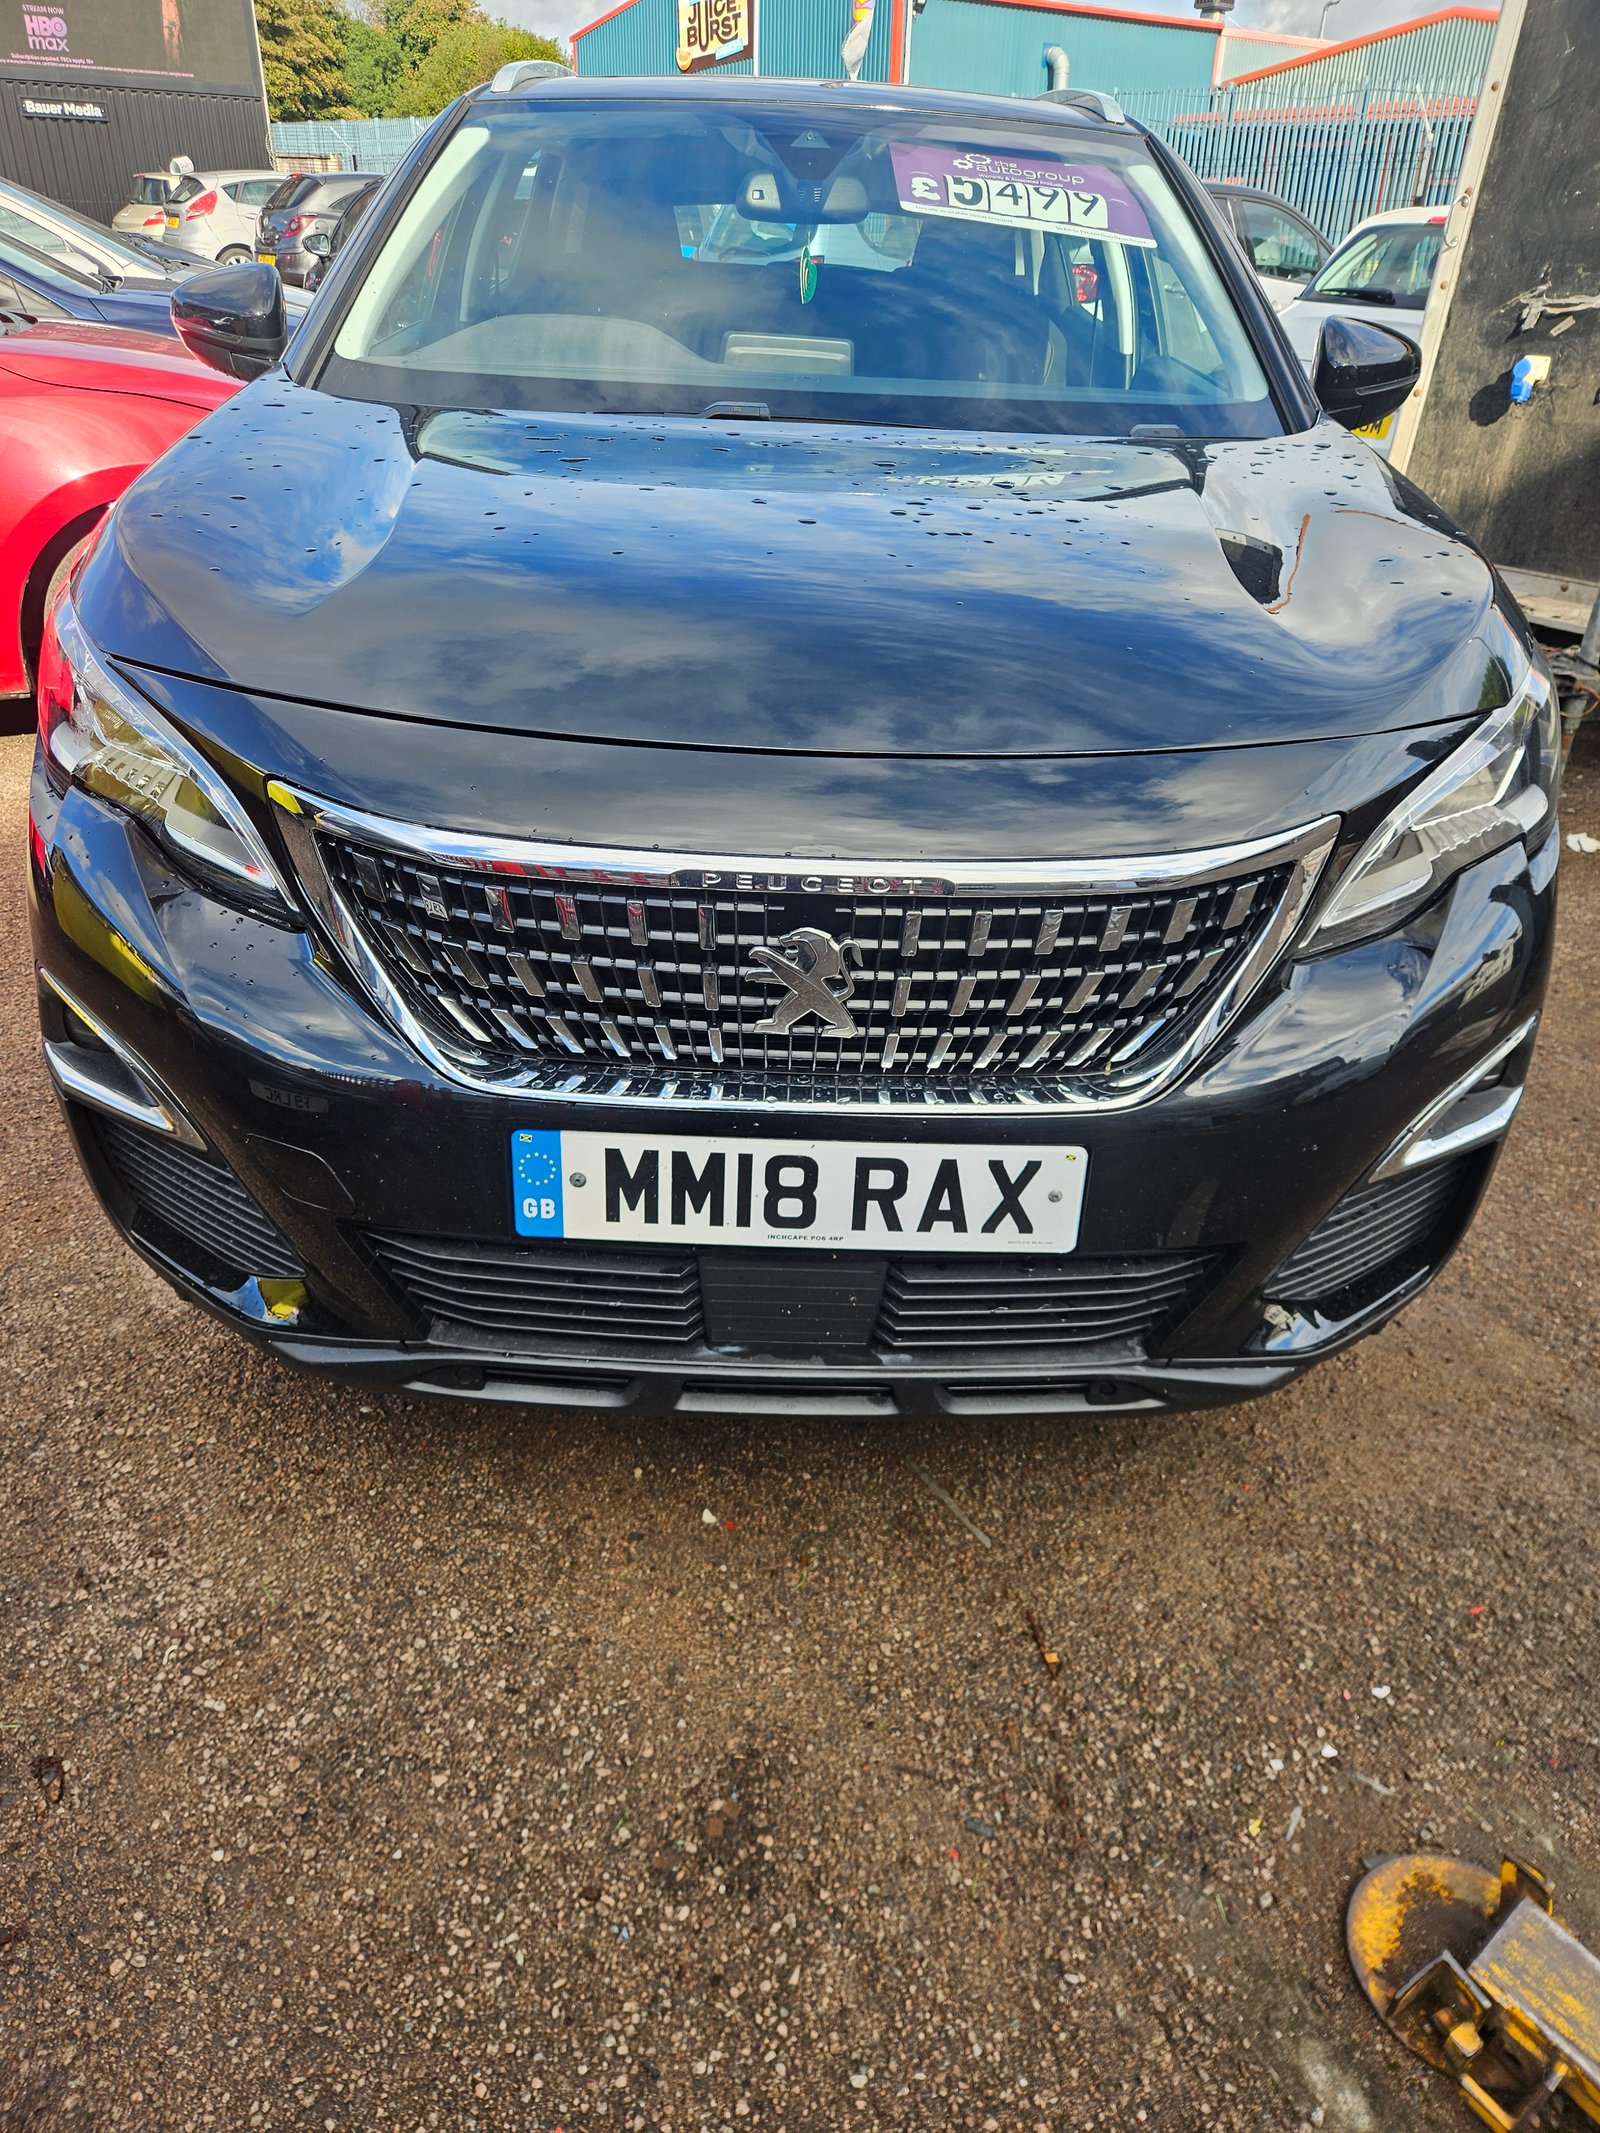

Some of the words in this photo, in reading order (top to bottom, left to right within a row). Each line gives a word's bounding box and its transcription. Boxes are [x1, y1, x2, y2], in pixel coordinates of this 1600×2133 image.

[22, 4, 48, 13] STREAM
[47, 6, 64, 15] NOW
[23, 14, 68, 38] HBO
[687, 12, 741, 52] BURST
[27, 35, 70, 52] max
[24, 100, 63, 115] Bauer
[63, 102, 103, 118] Media
[976, 164, 1085, 186] autogroup
[994, 160, 1017, 169] the
[702, 872, 922, 895] PEUGEOT
[605, 1148, 820, 1229] MM18
[851, 1155, 1043, 1235] RAX
[522, 1197, 556, 1221] GB
